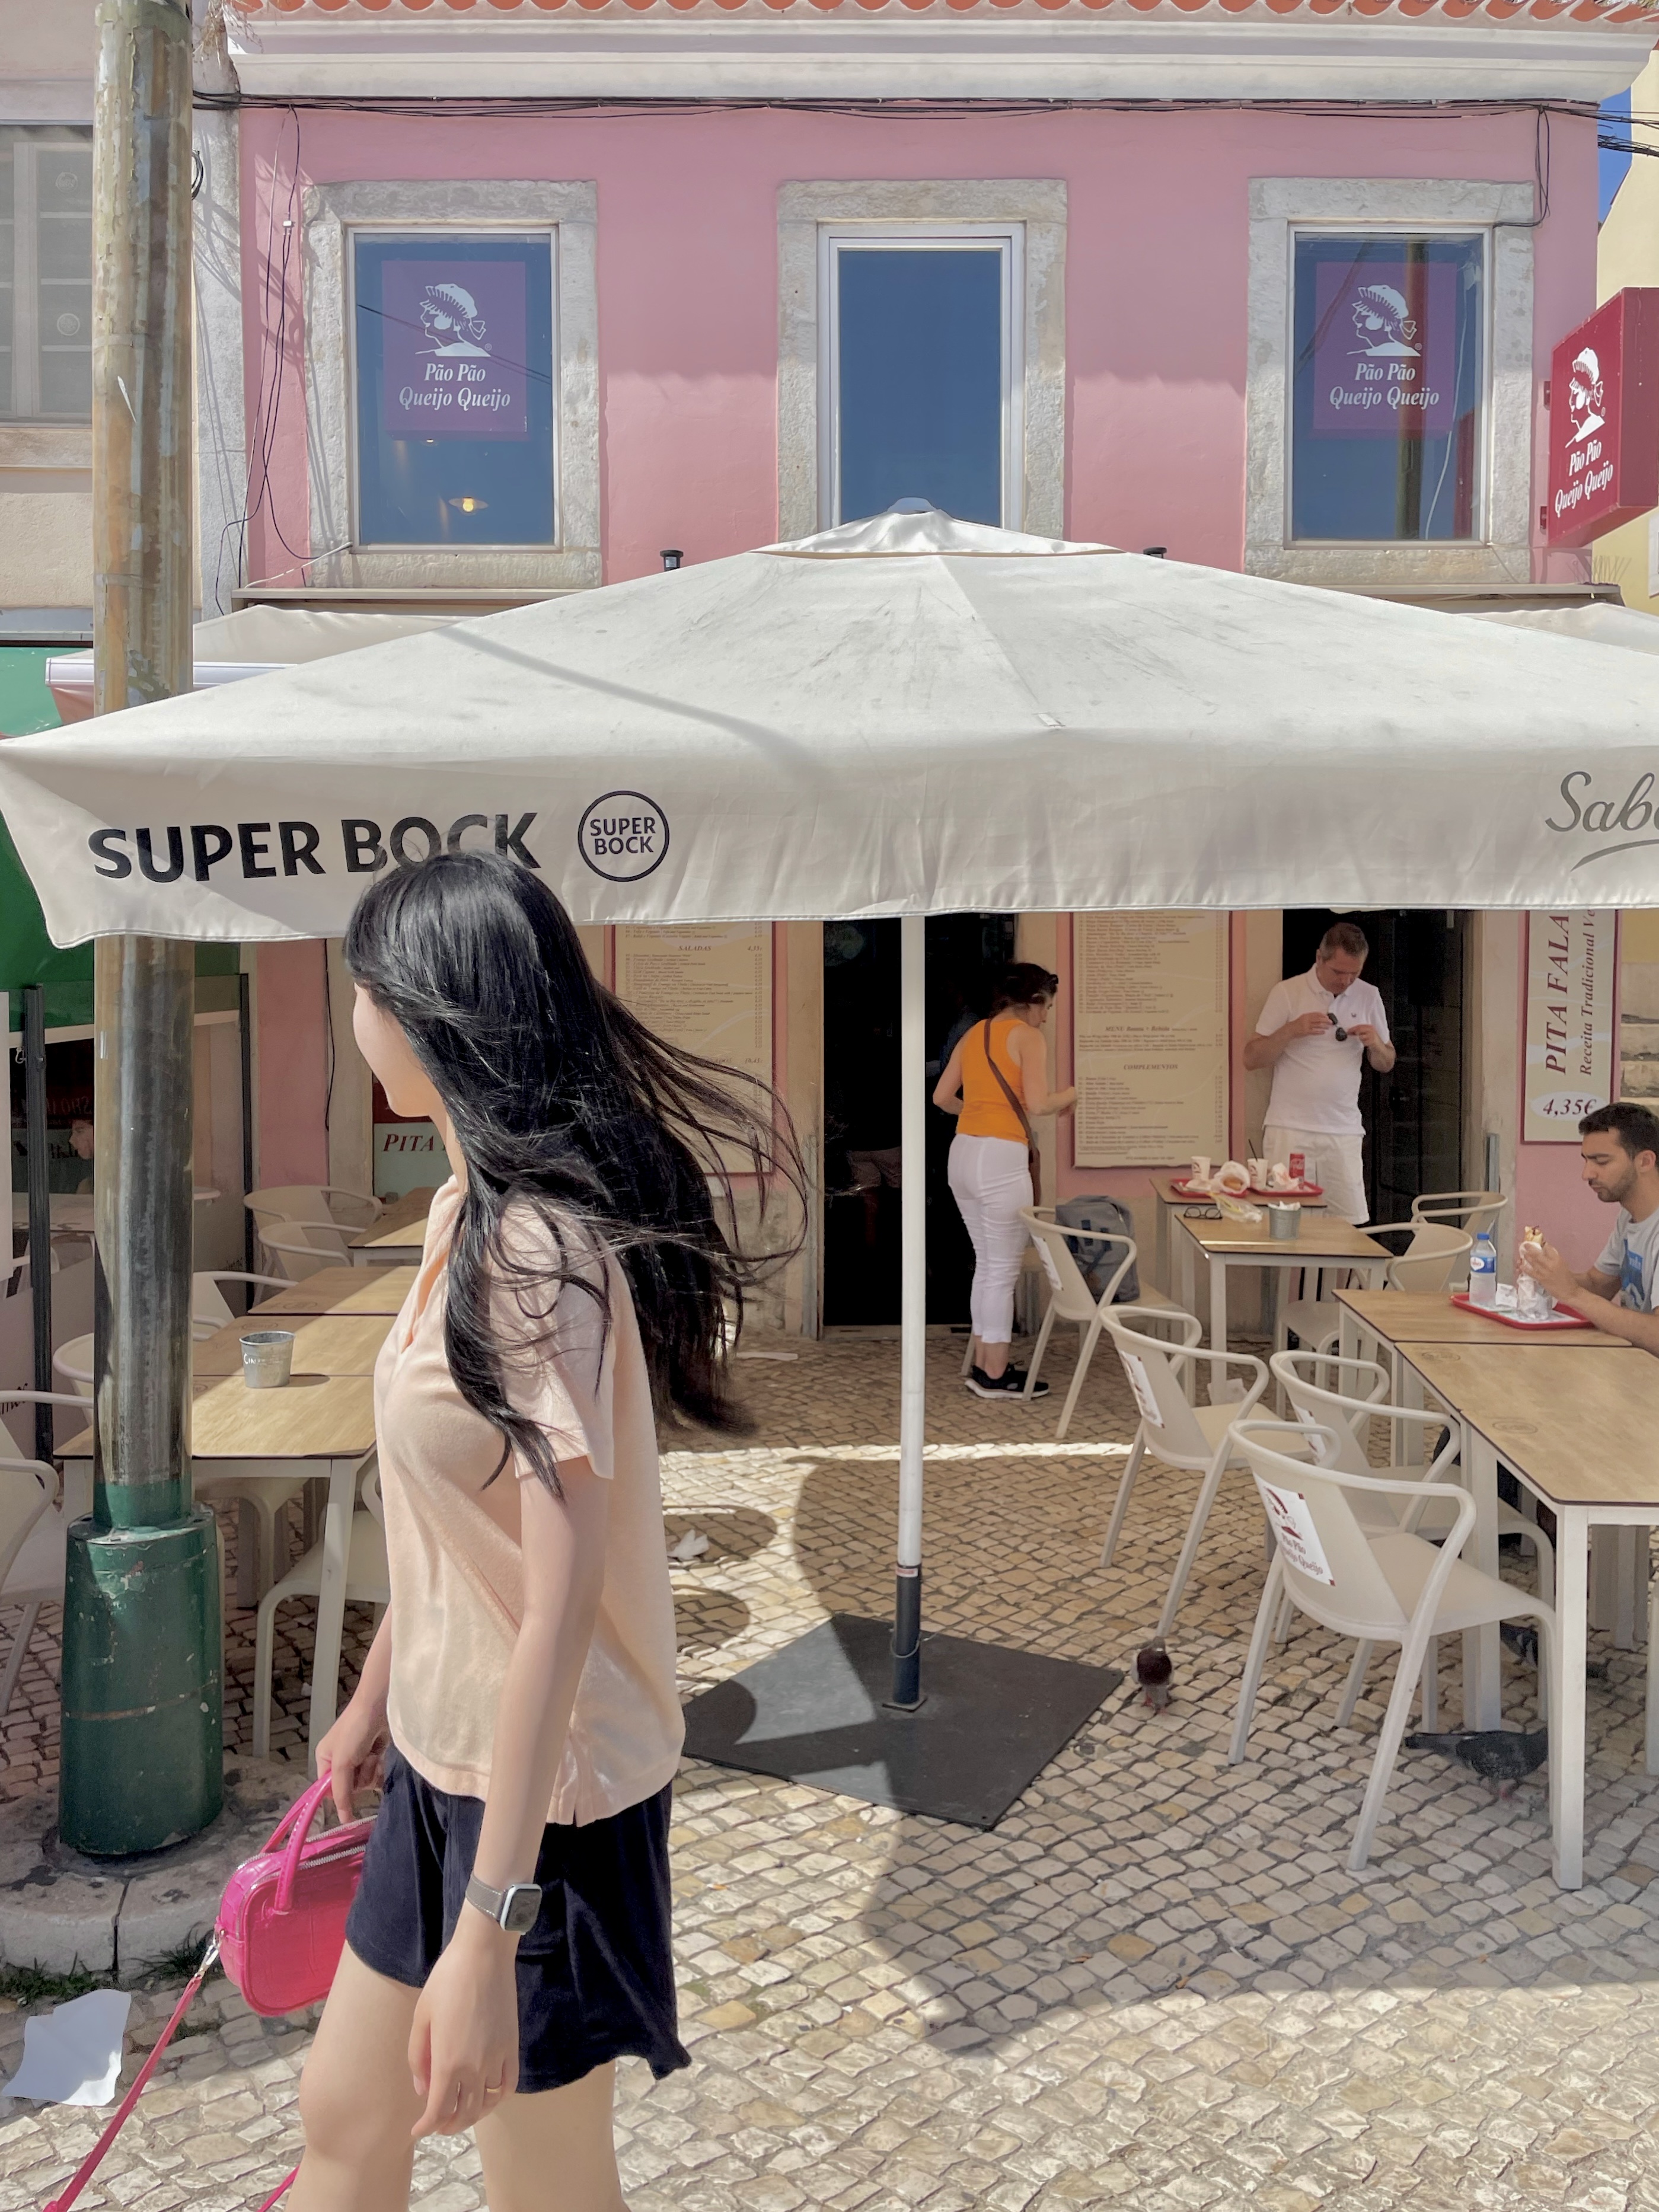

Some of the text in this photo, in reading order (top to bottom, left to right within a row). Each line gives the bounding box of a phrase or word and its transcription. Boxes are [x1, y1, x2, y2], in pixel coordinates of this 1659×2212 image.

[424, 363, 486, 381] Pão Pão
[1354, 362, 1416, 381] Pão Pão
[399, 386, 511, 411] Queijo Queijo
[1329, 385, 1440, 410] Queijo Queijo
[1555, 460, 1613, 518] Queijo Queijo
[1545, 771, 1659, 832] Sab
[590, 817, 656, 837] SUPER
[87, 812, 539, 883] SUPER BOCK
[595, 835, 654, 855] BOCK
[1581, 933, 1595, 1017] Tradicional
[1545, 914, 1569, 1075] PITA FALA
[1580, 1023, 1593, 1076] Receita
[1543, 1098, 1597, 1116] 4,35€
[382, 1133, 436, 1152] PITA
